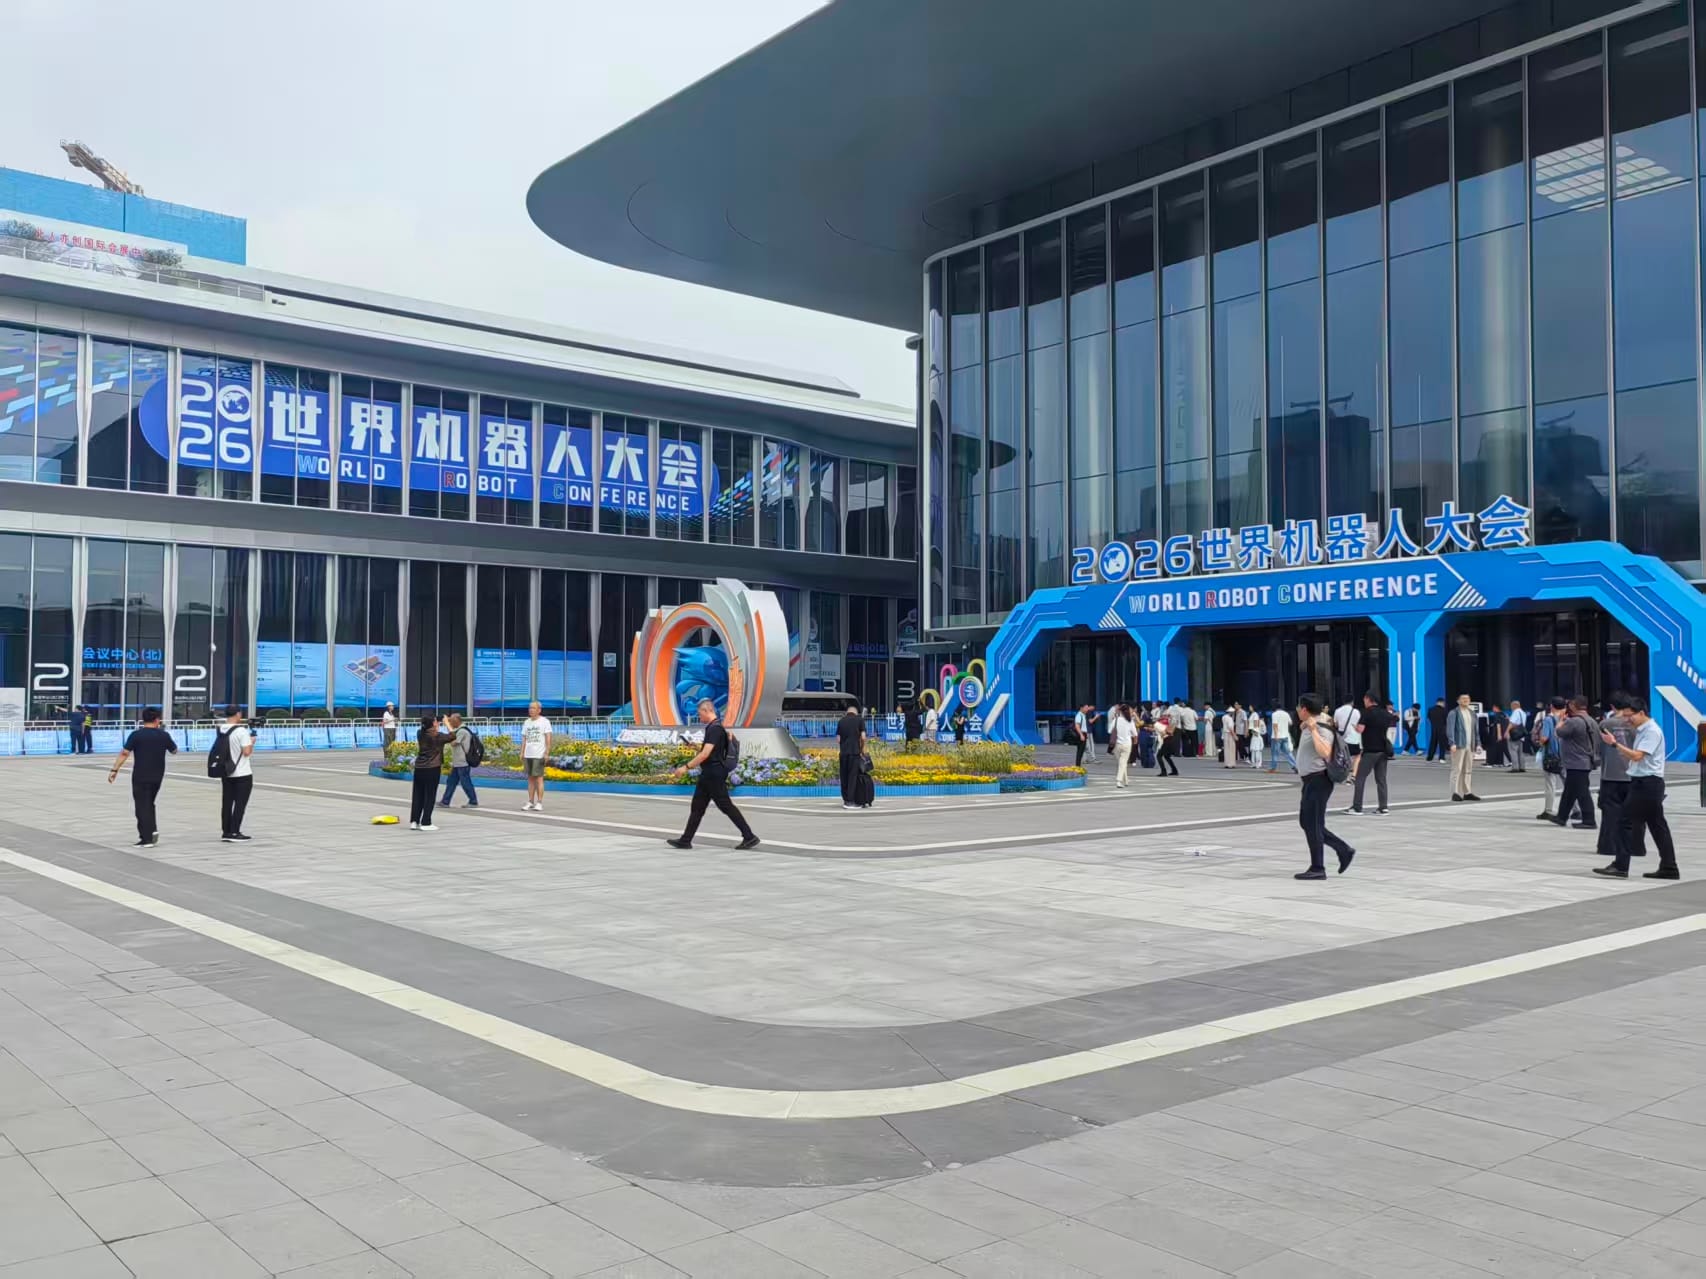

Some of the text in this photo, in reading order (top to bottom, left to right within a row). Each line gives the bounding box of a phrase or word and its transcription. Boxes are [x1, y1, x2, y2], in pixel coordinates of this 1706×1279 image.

[36, 227, 147, 257] 北人亦创国际会展中
[180, 421, 252, 464] 26
[269, 390, 698, 488] 世界机器人大会
[298, 455, 690, 511] WORLD ROBOT CONFERENCE
[1072, 495, 1532, 584] 2026世界机器人大会
[1129, 573, 1438, 613] WORLD ROBOT CONFERENCE
[34, 663, 69, 690] 2
[174, 665, 207, 691] 2
[897, 680, 915, 698] 3
